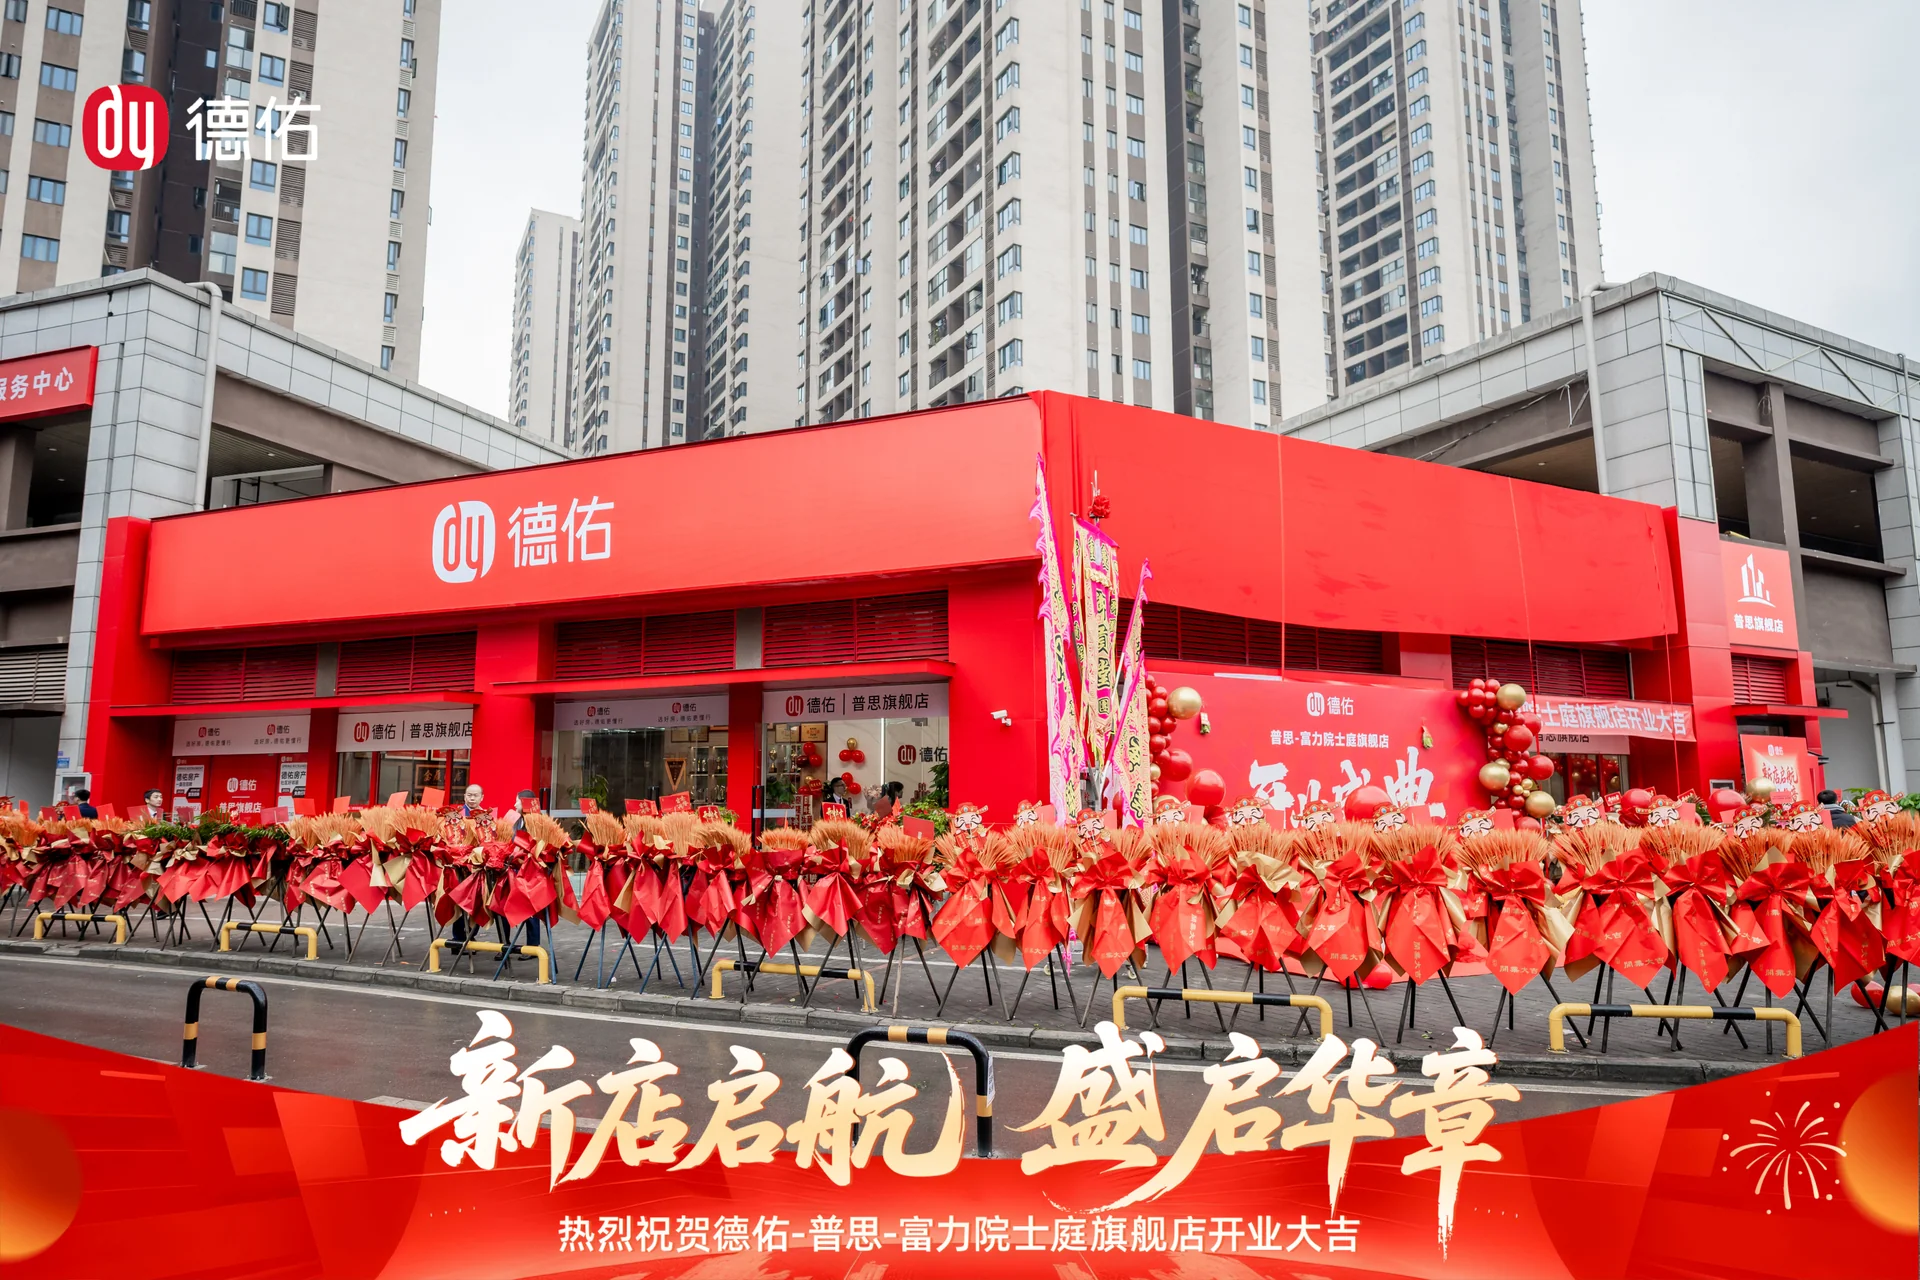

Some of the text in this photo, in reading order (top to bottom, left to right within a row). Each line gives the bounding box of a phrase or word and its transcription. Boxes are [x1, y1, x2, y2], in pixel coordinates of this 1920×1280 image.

[508, 496, 614, 568] 德佑
[1734, 614, 1784, 633] 普思旗舰店
[597, 707, 611, 716] 德佑
[683, 704, 697, 712] 德佑
[807, 697, 836, 713] 德佑
[852, 693, 929, 712] 普思旗舰店
[1327, 696, 1354, 715] 德佑
[208, 728, 220, 737] 德佑
[277, 725, 290, 734] 德佑
[372, 724, 396, 740] 德佑
[410, 721, 473, 739] 普思旗舰店
[1270, 730, 1389, 748] 普思-富力院士庭旗舰店
[919, 746, 948, 762] 德佑
[240, 779, 257, 791] 德佑
